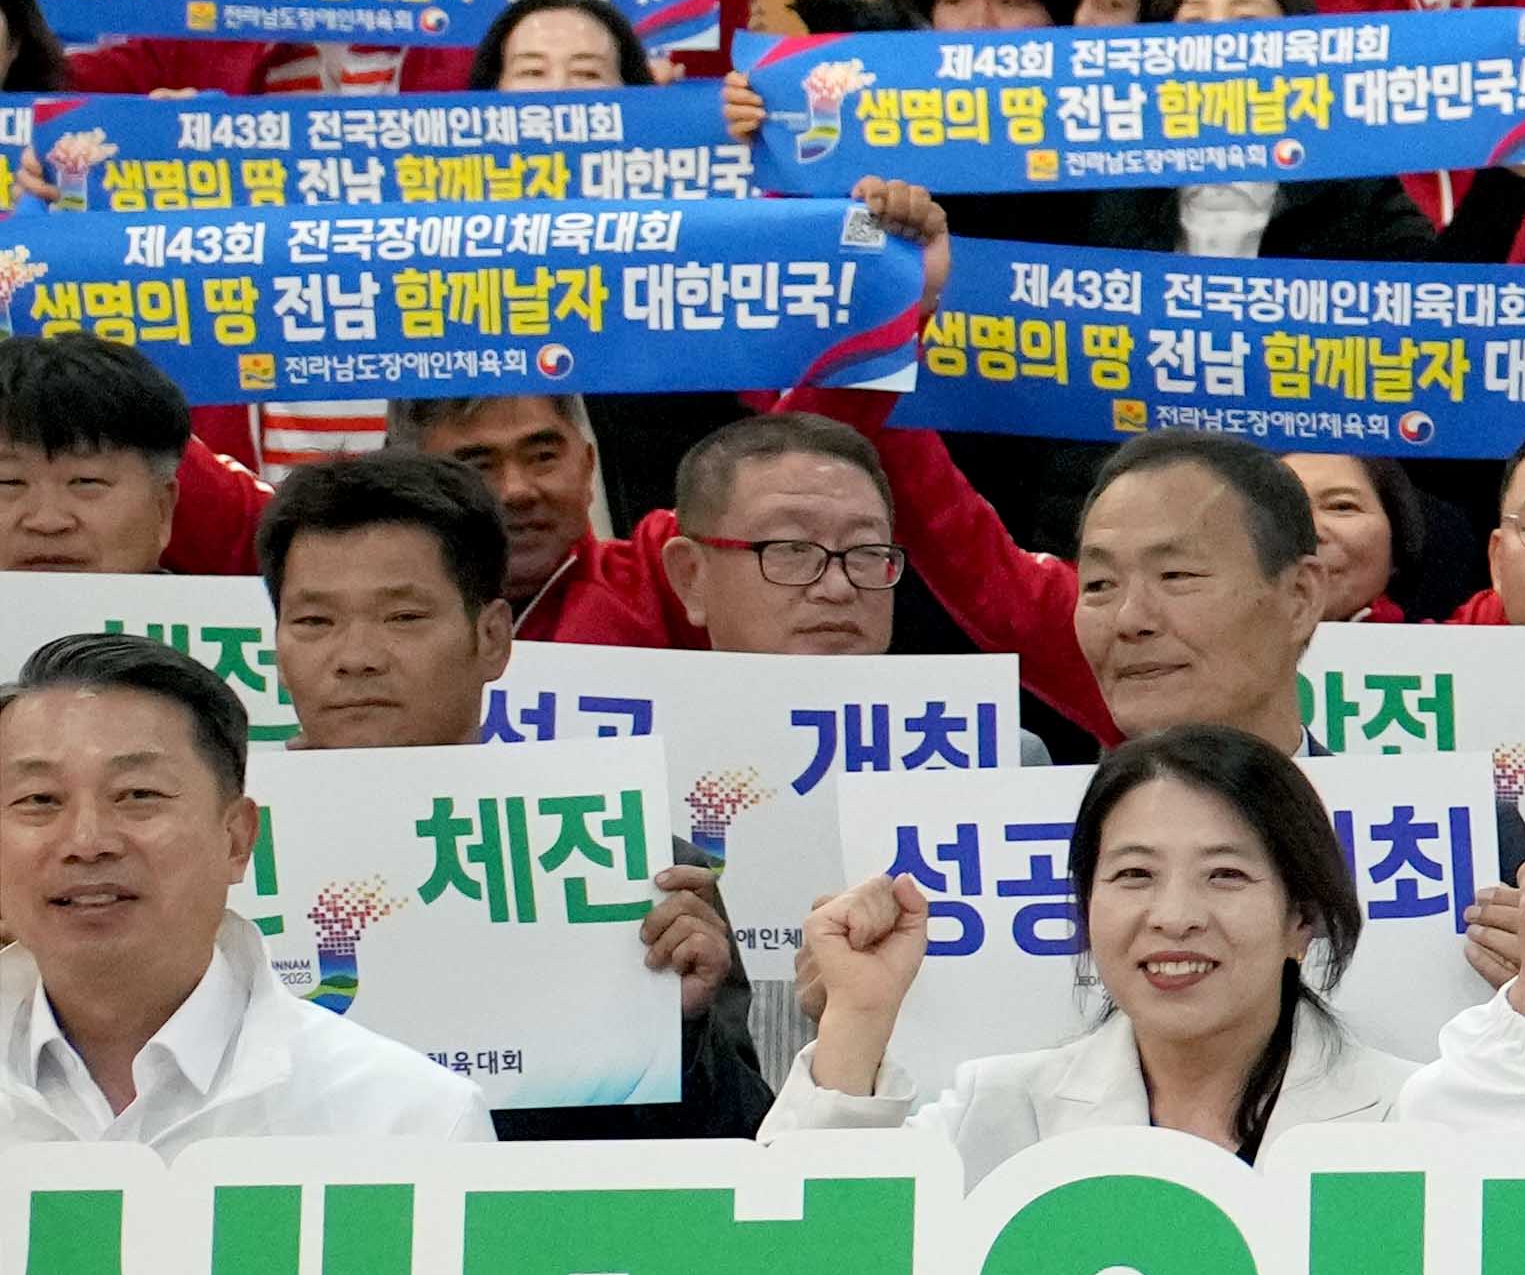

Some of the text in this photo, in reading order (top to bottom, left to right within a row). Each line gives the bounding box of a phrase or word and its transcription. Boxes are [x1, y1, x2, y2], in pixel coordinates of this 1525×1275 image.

[124, 210, 682, 267] 제43회 전국장애인체육대회
[24, 262, 856, 346] 생명의 땅 전남 함께날자 대한민국!
[1010, 263, 1141, 315] 제43회
[285, 349, 527, 384] 전라남도장애인체육회
[921, 315, 1067, 384] 생명의
[1082, 325, 1134, 389] 땅
[1147, 329, 1250, 395] 전남
[1262, 331, 1470, 402] 함께날자
[1150, 406, 1389, 440] 전라남도장애인체육회
[415, 789, 655, 925] 체전
[887, 823, 1079, 957] 성공
[1334, 806, 1477, 934] 최
